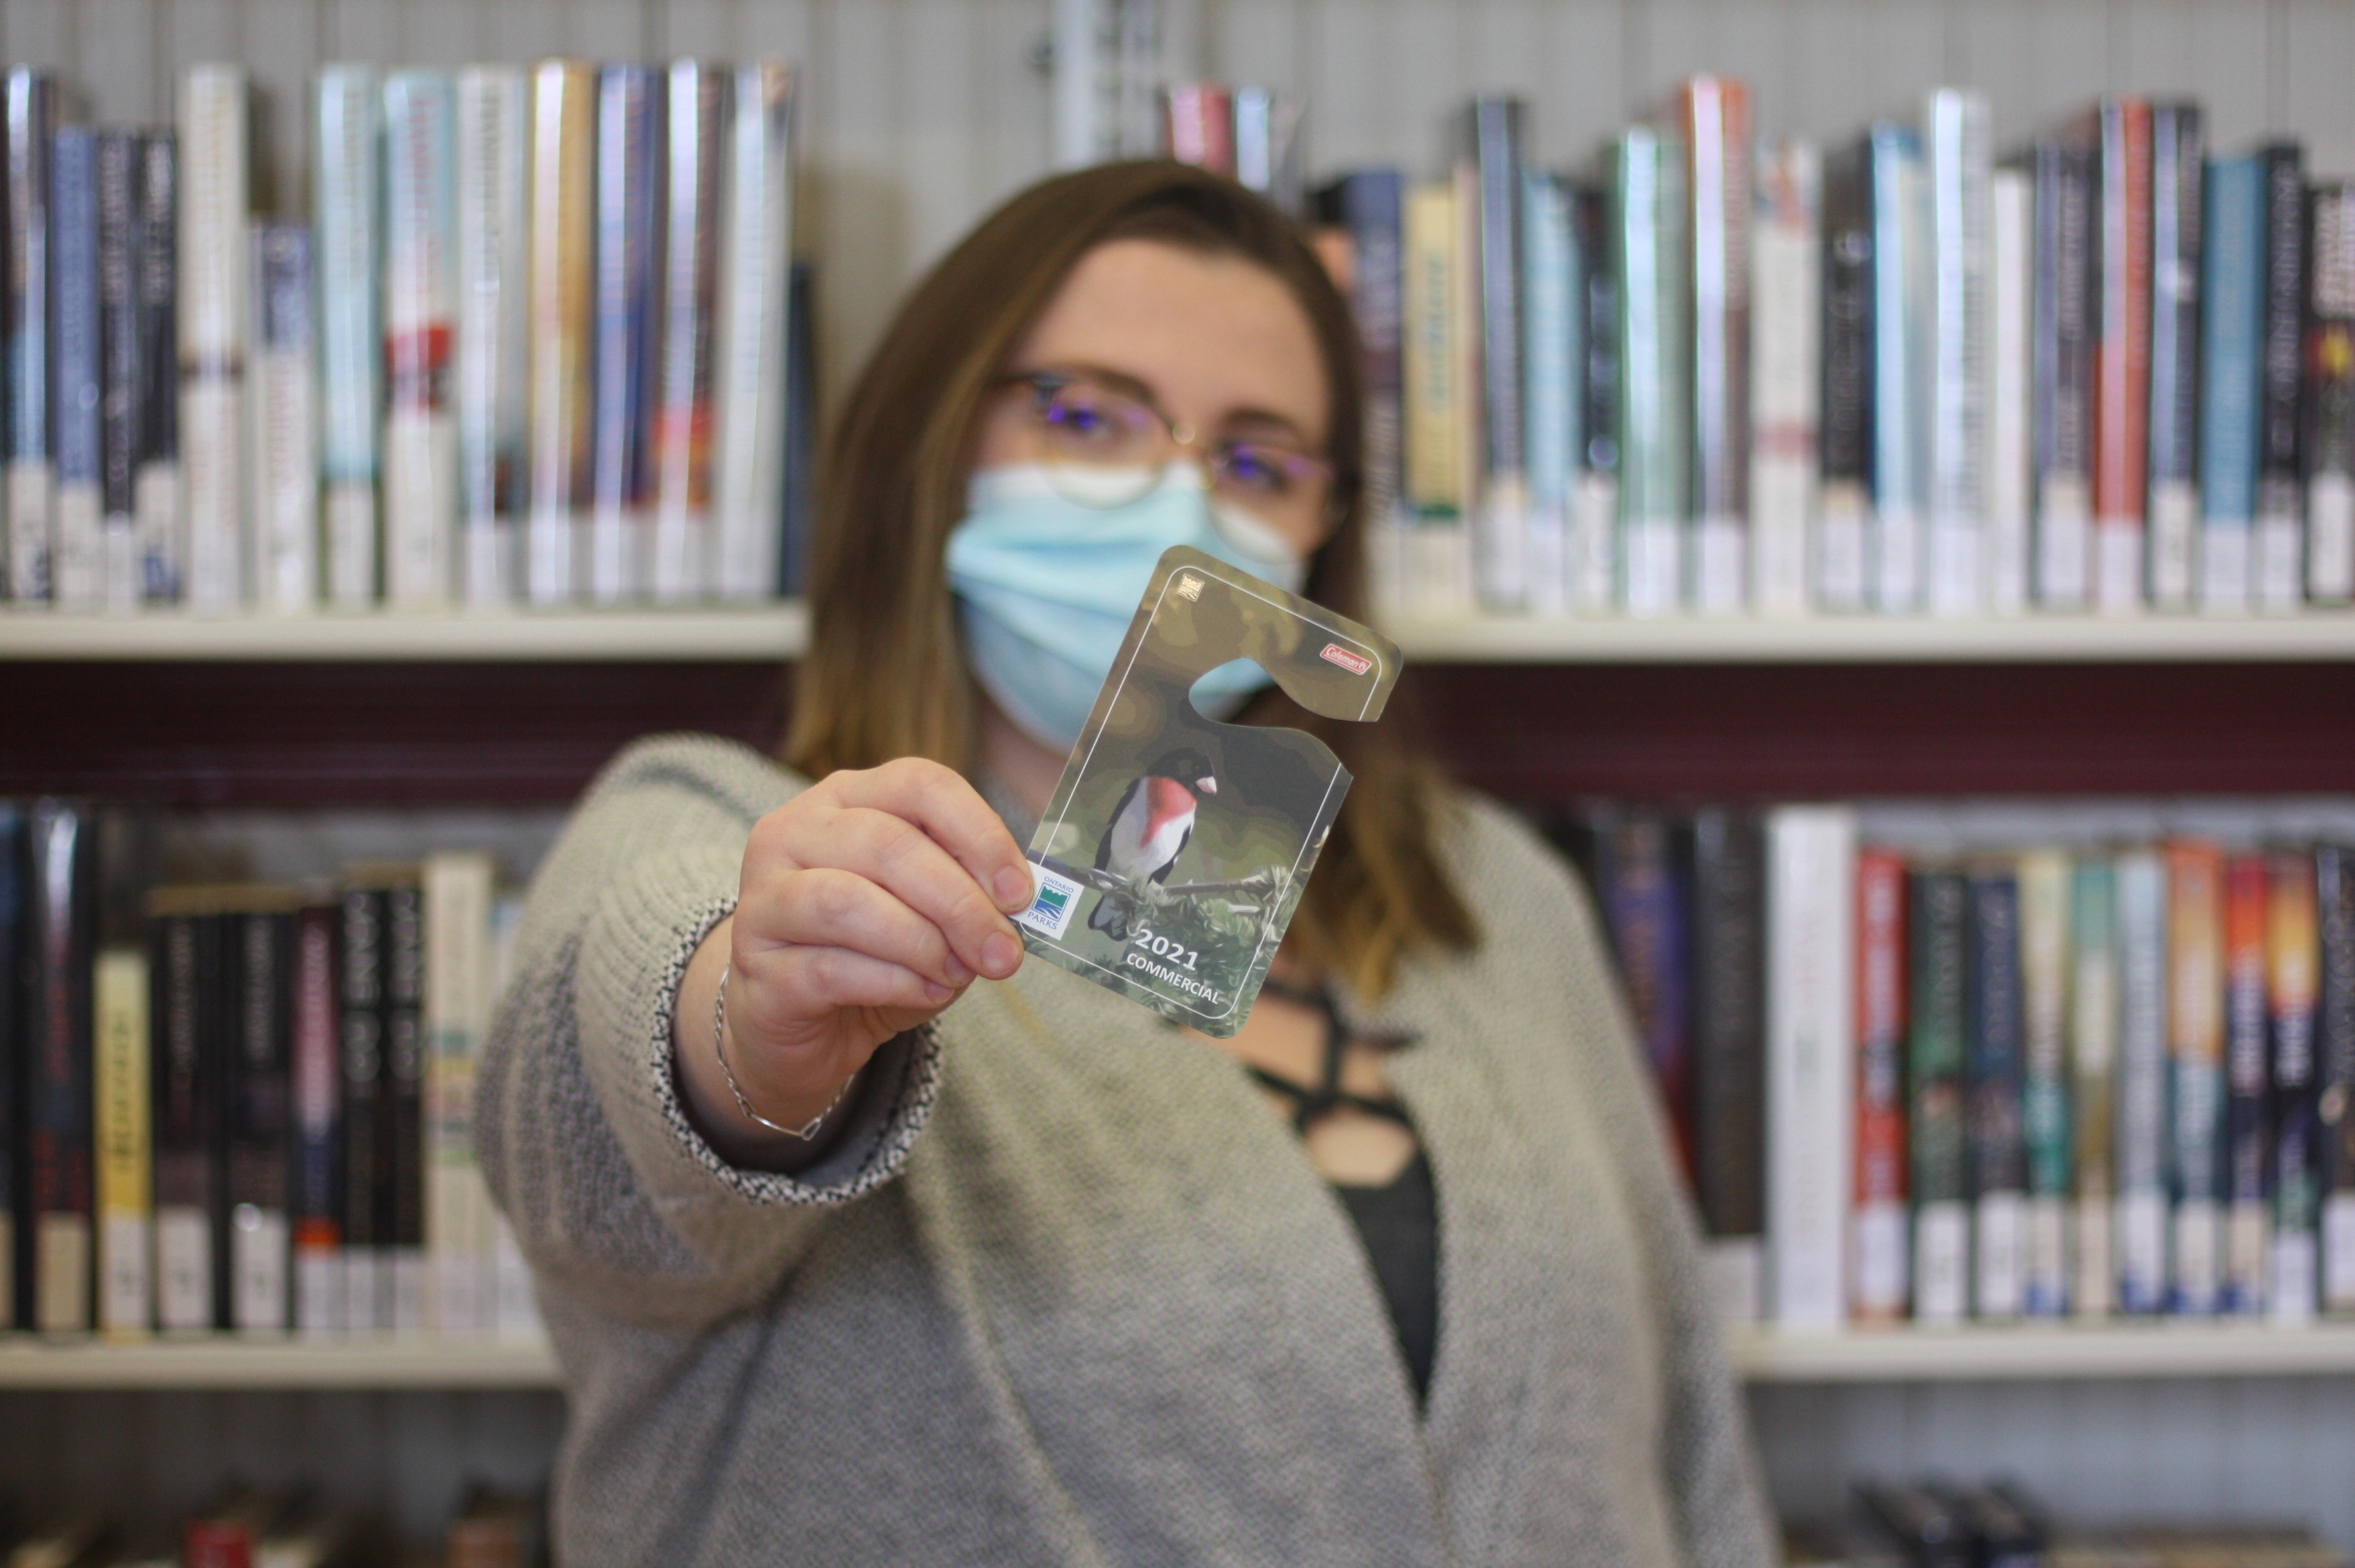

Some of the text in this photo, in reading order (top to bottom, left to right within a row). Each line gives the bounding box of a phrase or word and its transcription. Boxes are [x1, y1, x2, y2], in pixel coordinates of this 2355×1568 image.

[1326, 647, 1359, 668] Coleman
[1044, 876, 1074, 893] ONTARIO
[1027, 911, 1058, 930] PARKS
[1135, 929, 1198, 971] 2021
[1126, 953, 1219, 1004] COMMERCIAL
